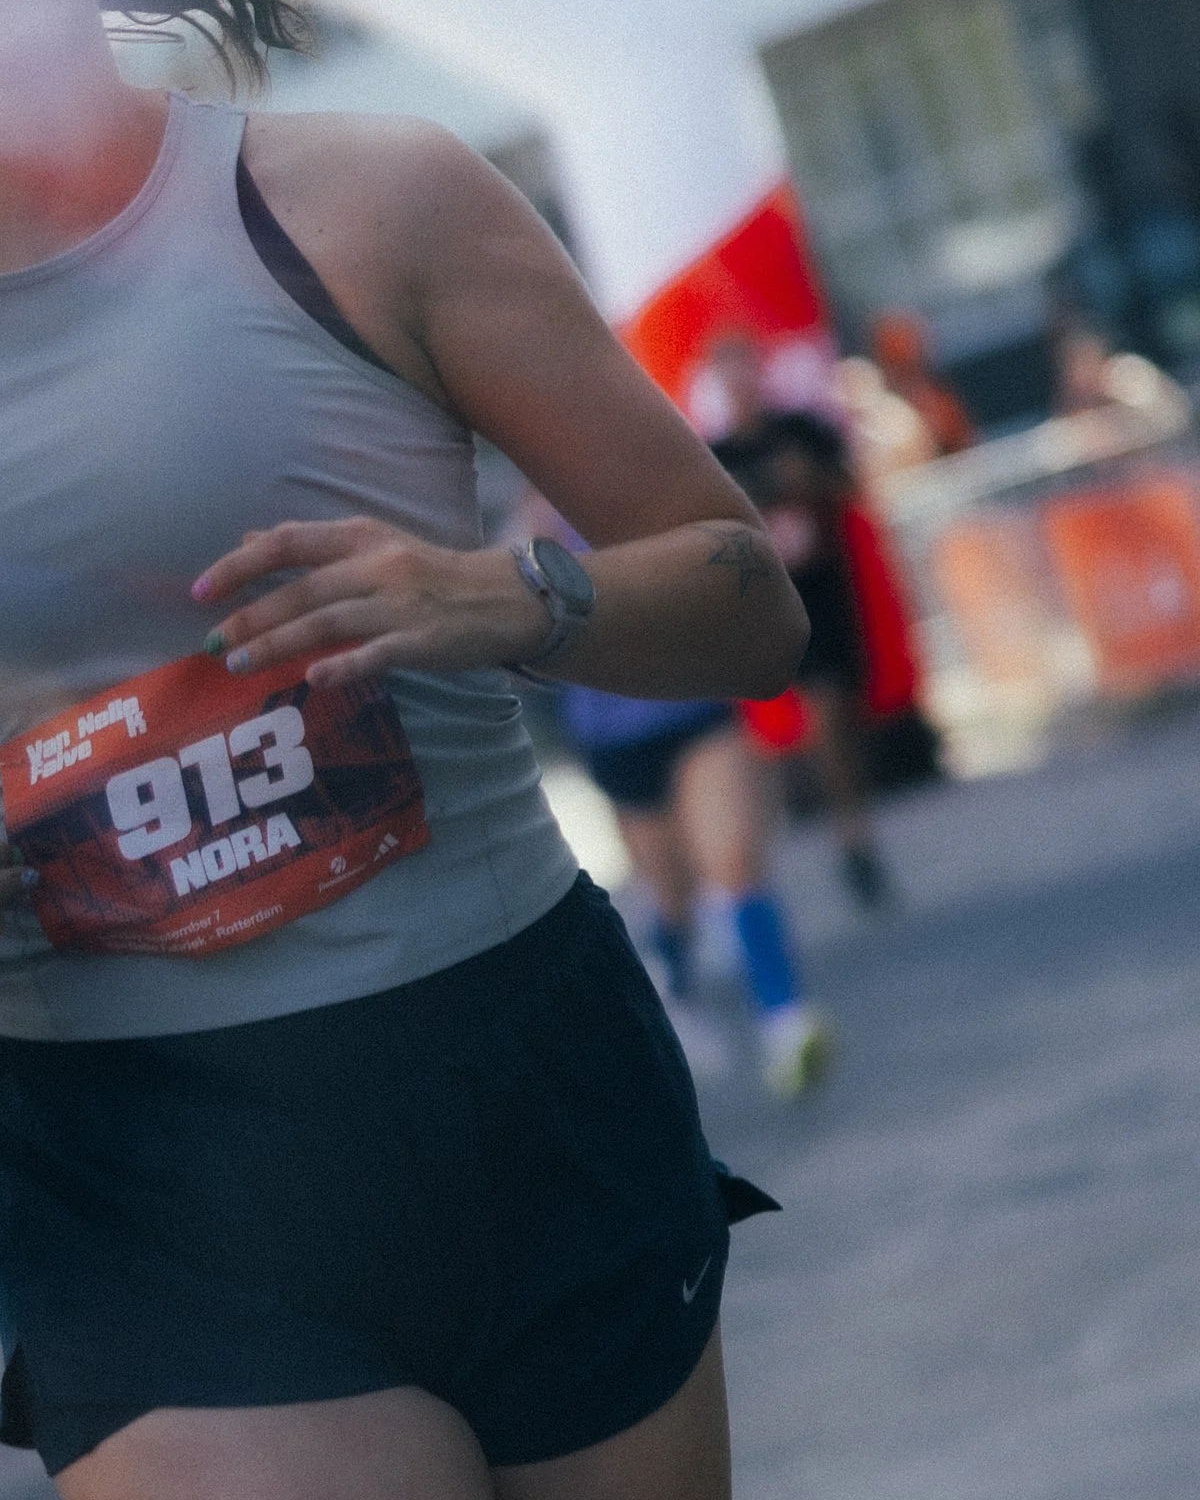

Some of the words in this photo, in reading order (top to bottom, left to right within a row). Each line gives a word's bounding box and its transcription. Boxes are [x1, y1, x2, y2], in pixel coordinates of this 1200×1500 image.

[106, 705, 315, 861] 913
[170, 812, 302, 897] NORA
[216, 903, 283, 938] Rotterdam
